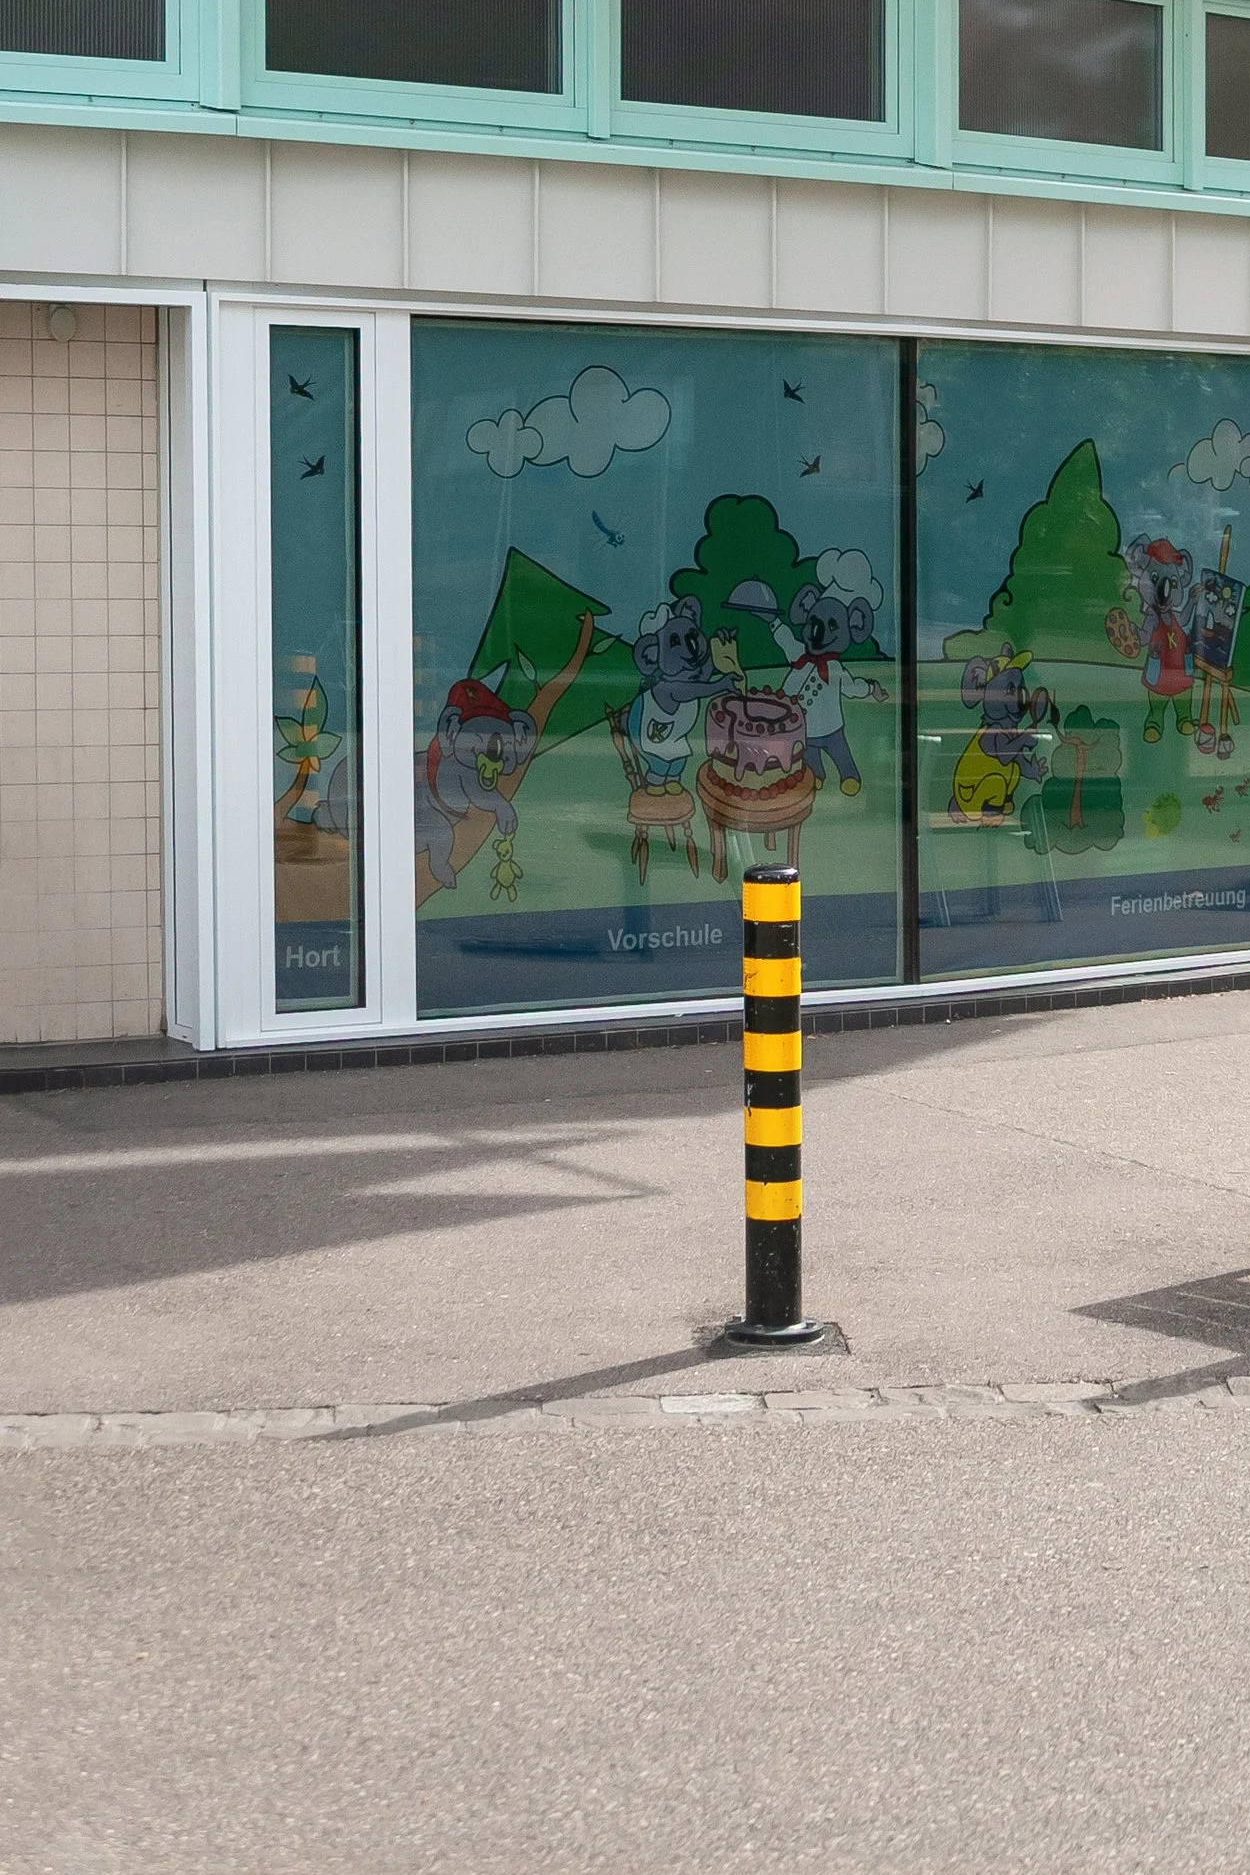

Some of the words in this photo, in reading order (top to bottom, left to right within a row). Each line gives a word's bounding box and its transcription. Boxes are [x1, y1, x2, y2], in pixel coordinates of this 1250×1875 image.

[1110, 888, 1247, 916] Ferienbetreuung
[607, 923, 723, 951] Vorschule
[286, 945, 341, 968] Hort
